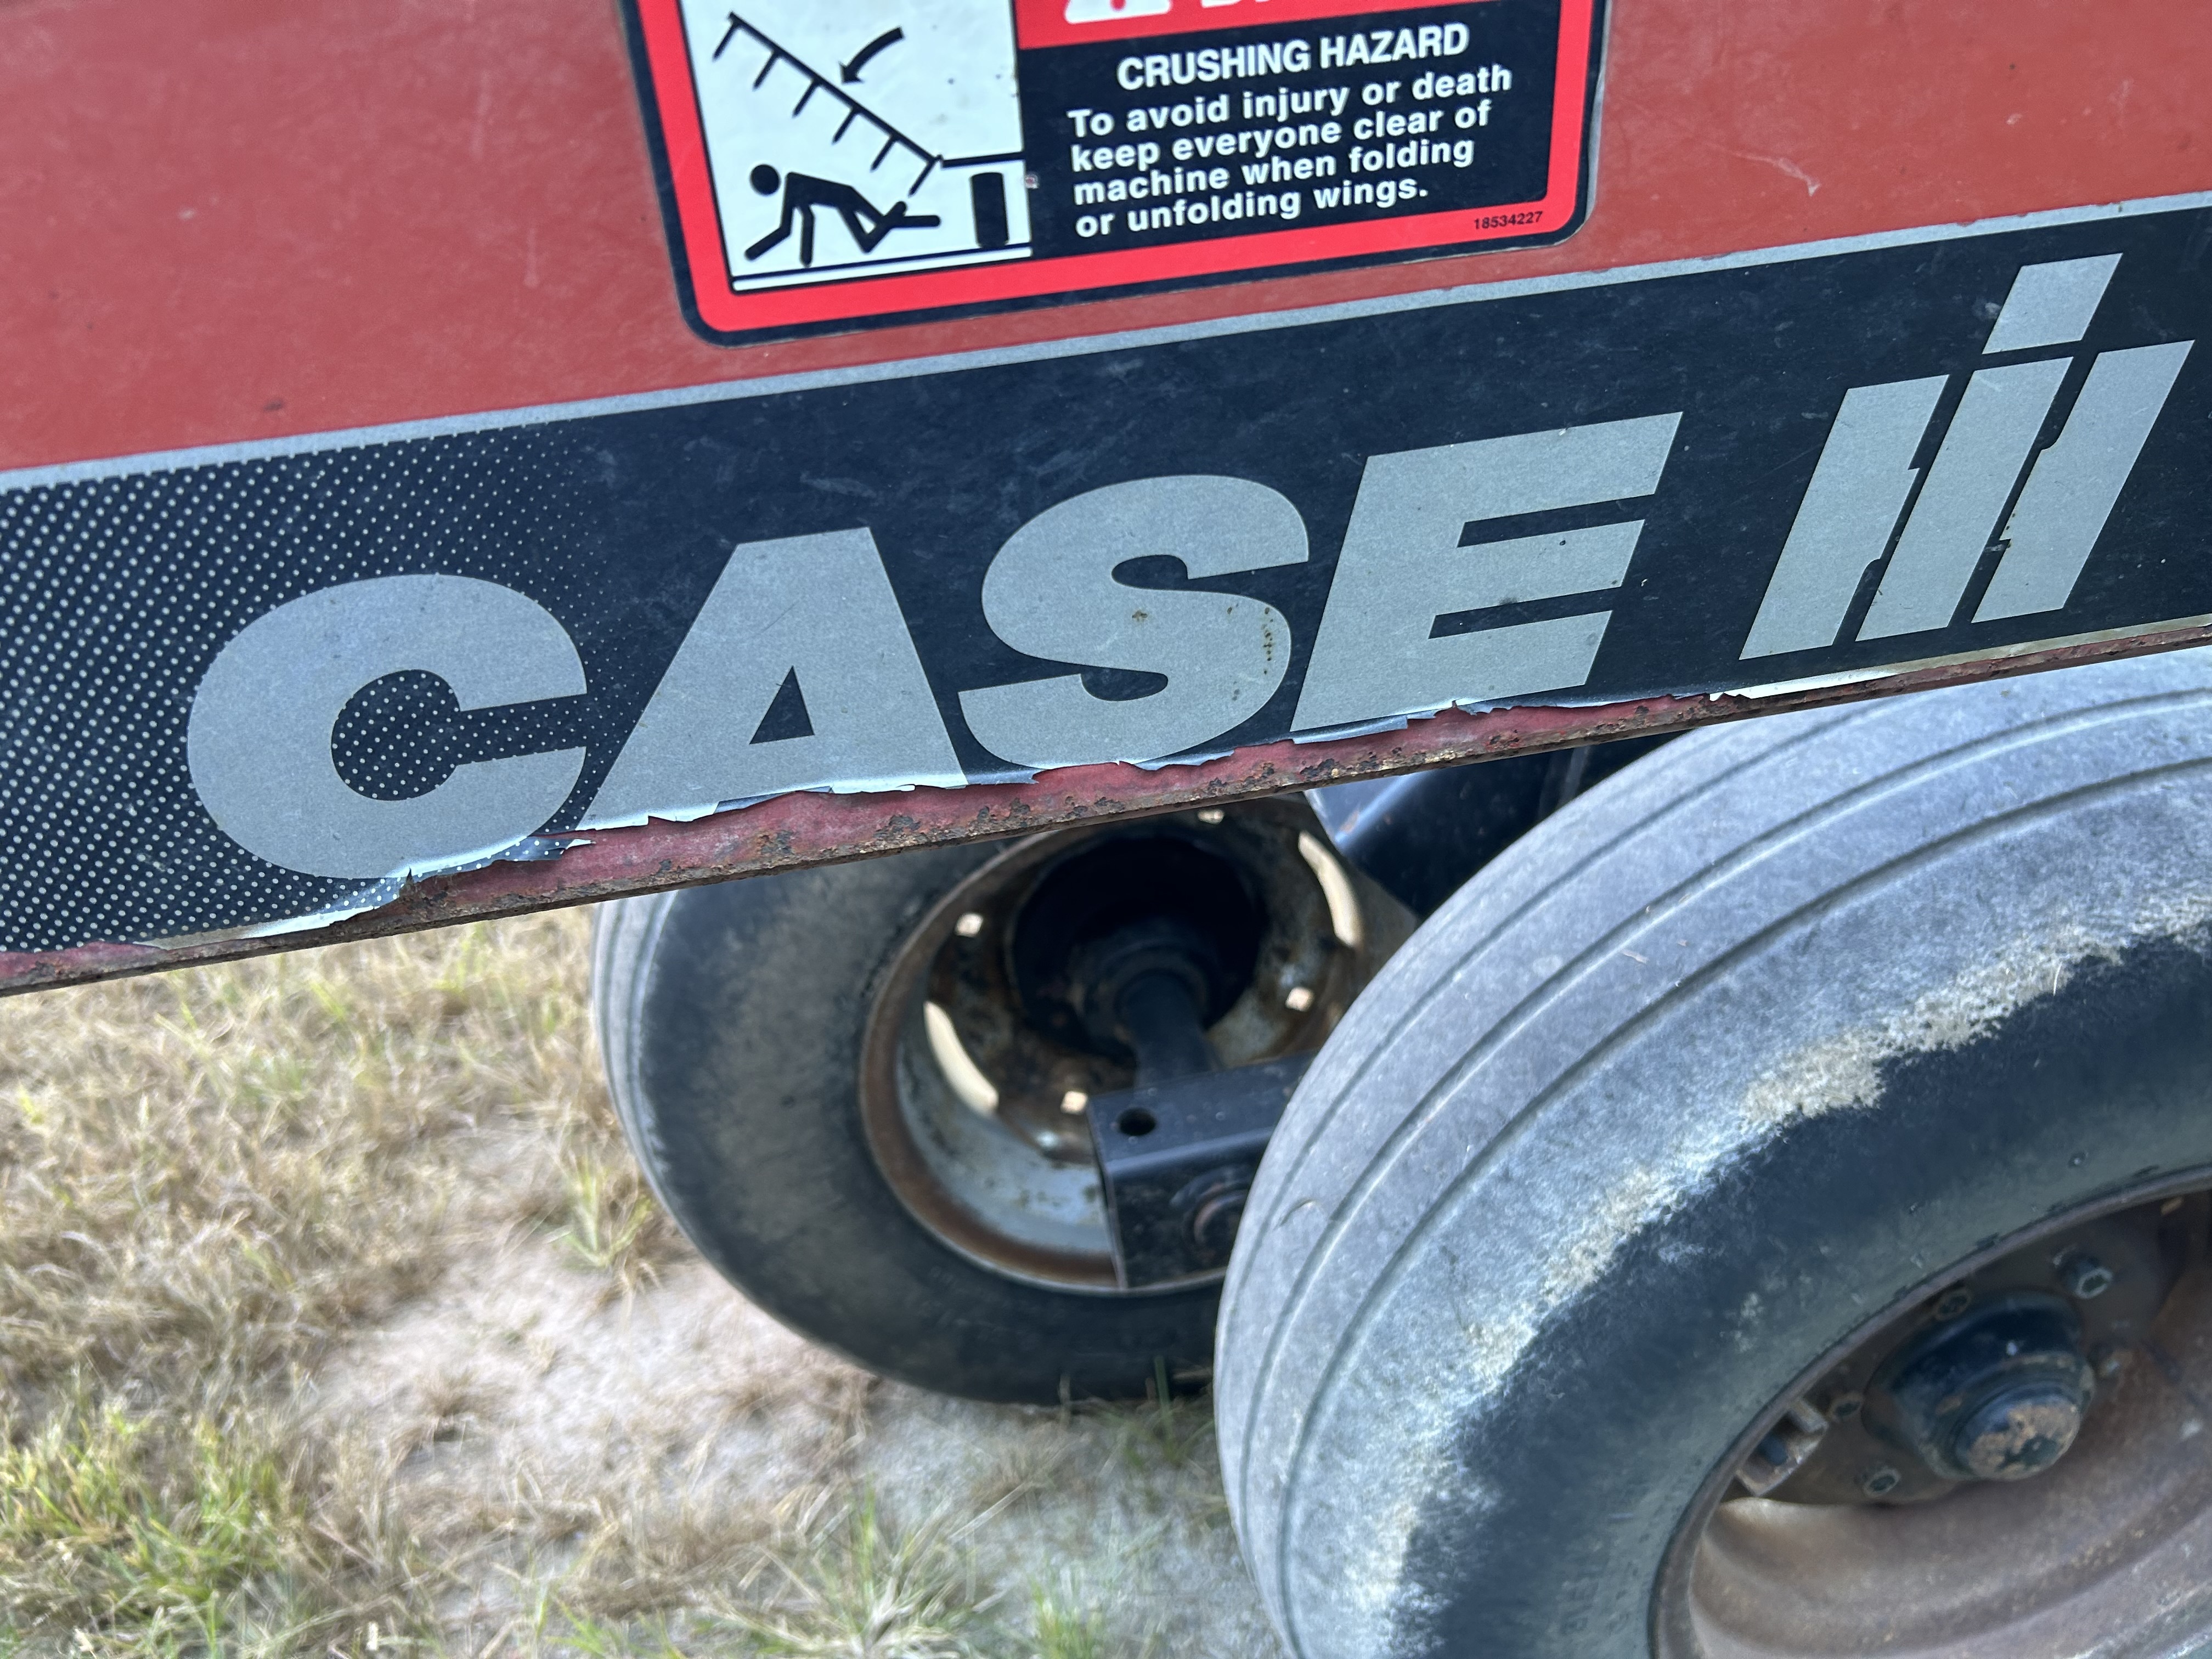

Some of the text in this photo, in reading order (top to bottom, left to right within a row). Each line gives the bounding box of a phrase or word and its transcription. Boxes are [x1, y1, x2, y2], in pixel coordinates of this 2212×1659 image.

[1117, 22, 1470, 91] CRUSHING HAZARD
[1066, 63, 1513, 138] To avoid injury or death
[1071, 99, 1492, 172] keep everyone clear of
[1074, 139, 1475, 205] machine when folding
[1075, 177, 1428, 238] or unfolding wings.
[1474, 211, 1543, 229] 18534227
[188, 411, 1683, 879] CASE
